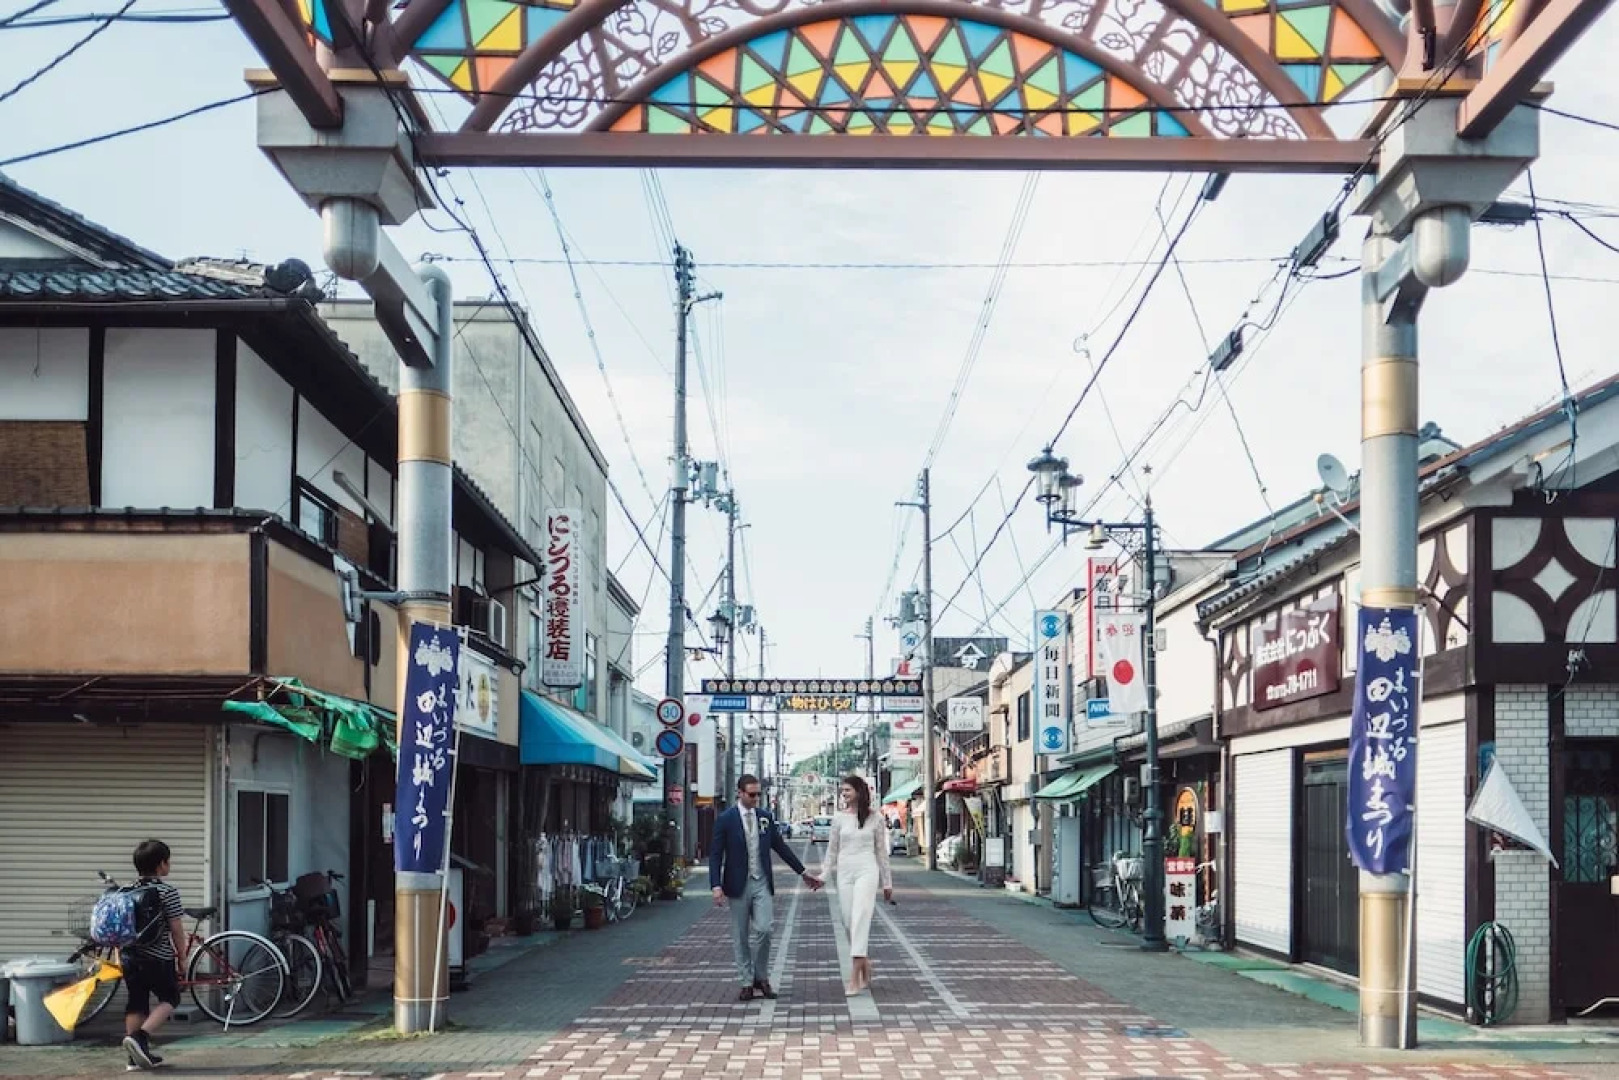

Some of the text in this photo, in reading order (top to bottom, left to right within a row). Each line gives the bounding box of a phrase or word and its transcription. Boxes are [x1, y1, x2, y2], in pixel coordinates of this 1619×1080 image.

[411, 690, 436, 861] 田辺城まつり
[663, 706, 679, 718] 30
[1362, 677, 1396, 859] 田辺城まつり
